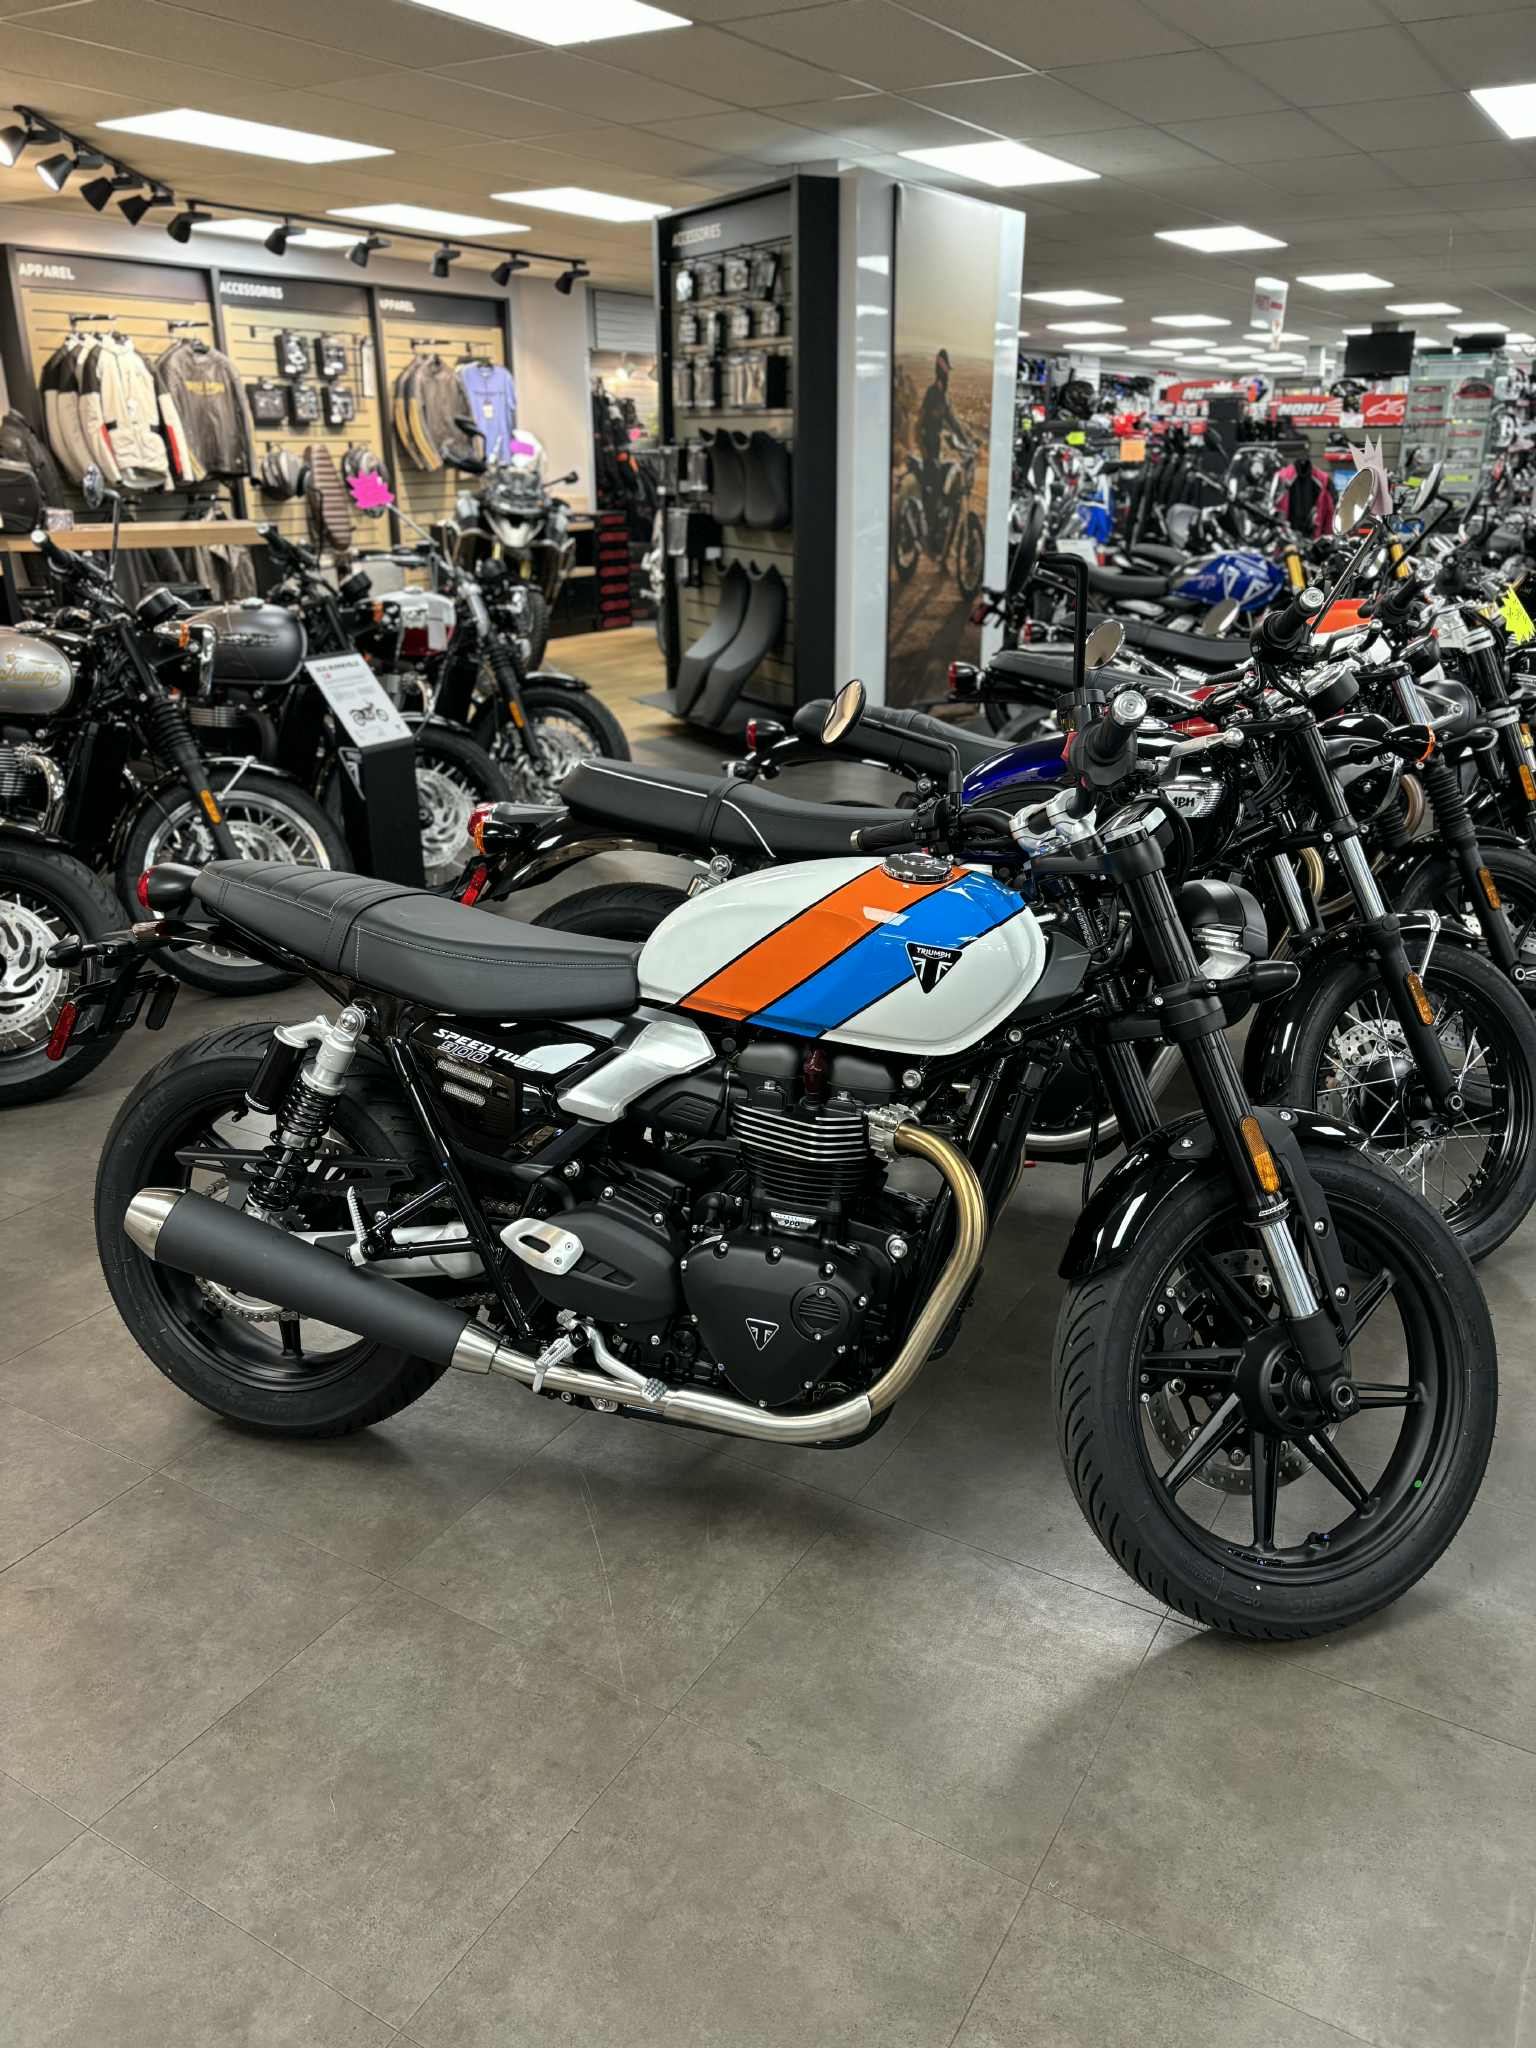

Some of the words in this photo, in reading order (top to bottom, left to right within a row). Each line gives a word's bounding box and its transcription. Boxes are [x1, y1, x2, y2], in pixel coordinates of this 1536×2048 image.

[672, 223, 721, 247] ACCESSORIES
[19, 263, 76, 281] APPAREL
[219, 281, 284, 300] ACCESSORIES
[379, 298, 416, 313] APPAREL
[916, 946, 952, 959] TRIUMPH
[432, 1028, 496, 1054] SPEED
[437, 1040, 490, 1064] 900
[784, 1219, 800, 1227] 900
